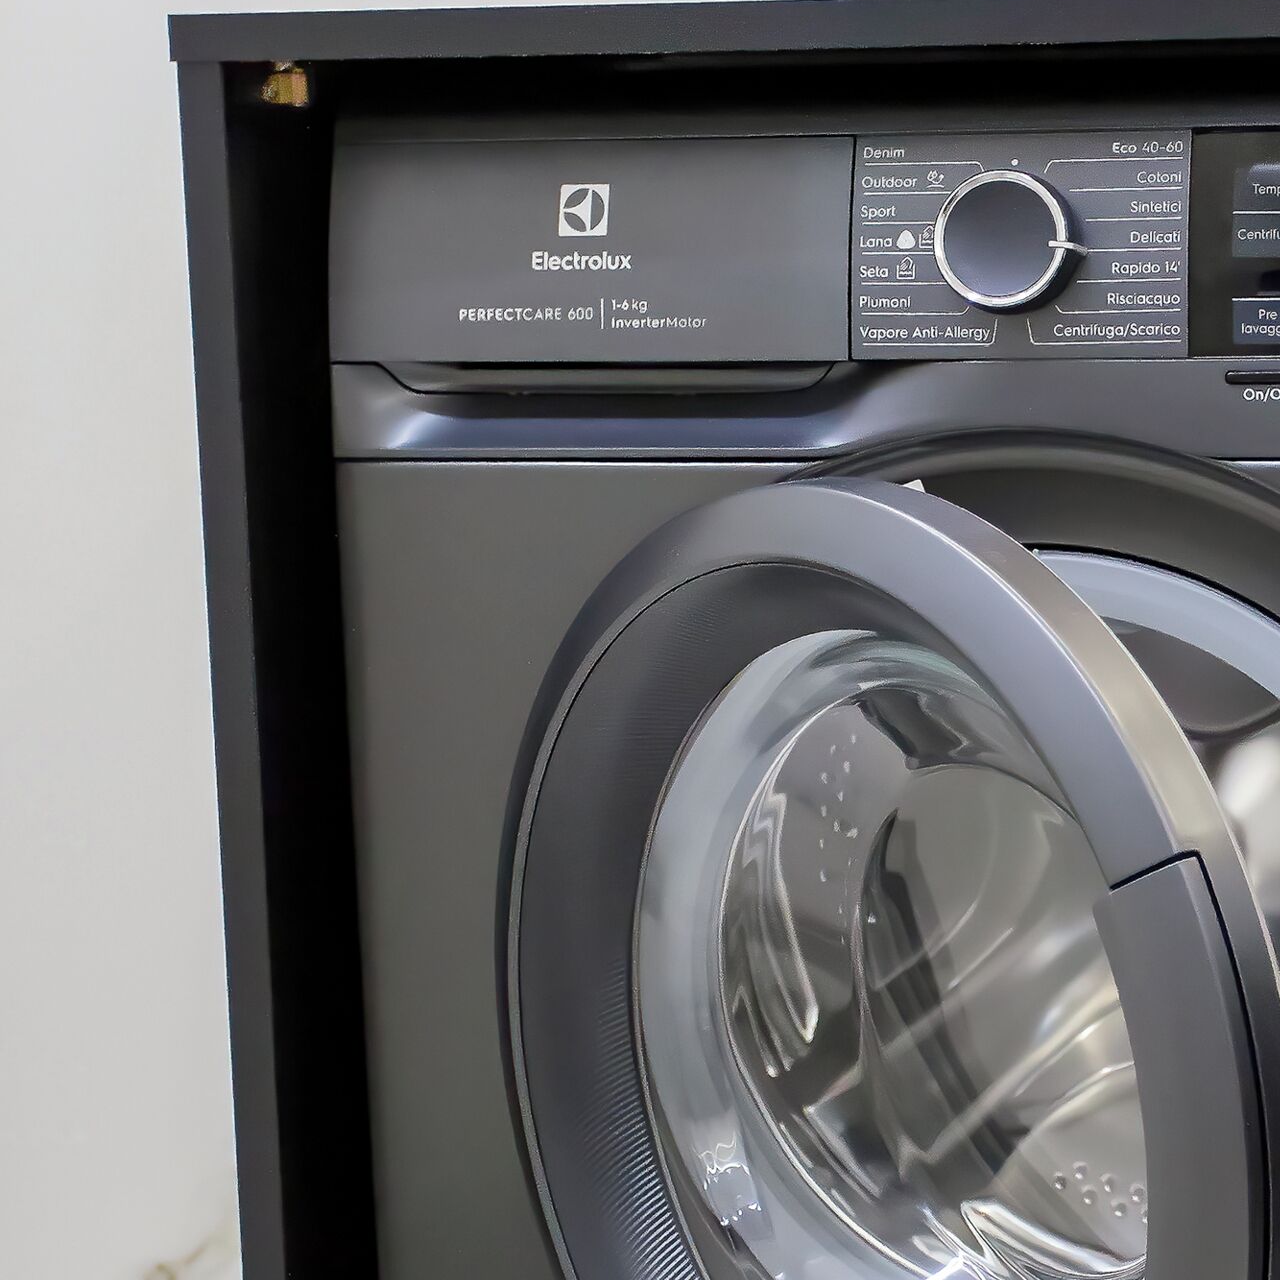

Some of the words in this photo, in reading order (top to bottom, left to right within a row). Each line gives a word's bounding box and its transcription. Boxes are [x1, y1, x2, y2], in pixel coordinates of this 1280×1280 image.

[863, 146, 905, 159] Denim
[1112, 142, 1137, 154] Eco
[1142, 141, 1184, 153] 40-60
[861, 176, 917, 189] Outdoor
[1136, 171, 1182, 183] Cotoni
[861, 205, 896, 220] Sport
[1130, 200, 1182, 213] Sintetici
[859, 235, 893, 248] Lana
[1130, 230, 1181, 243] Delicati
[531, 251, 632, 270] Electrolux
[859, 265, 889, 278] Seta
[1111, 261, 1161, 276] Rapido
[611, 299, 629, 311] 1-6
[631, 299, 648, 313] kg
[859, 295, 911, 309] Piumoni
[1107, 292, 1180, 308] Risciacquo
[459, 307, 562, 321] PERFECTCARE
[568, 307, 594, 320] 600
[1258, 309, 1278, 320] Pre
[611, 317, 706, 329] InverterMotor
[859, 326, 909, 341] Vapore
[912, 325, 990, 341] Anti-Allergy
[1054, 323, 1180, 339] Centrifuga/Scarico
